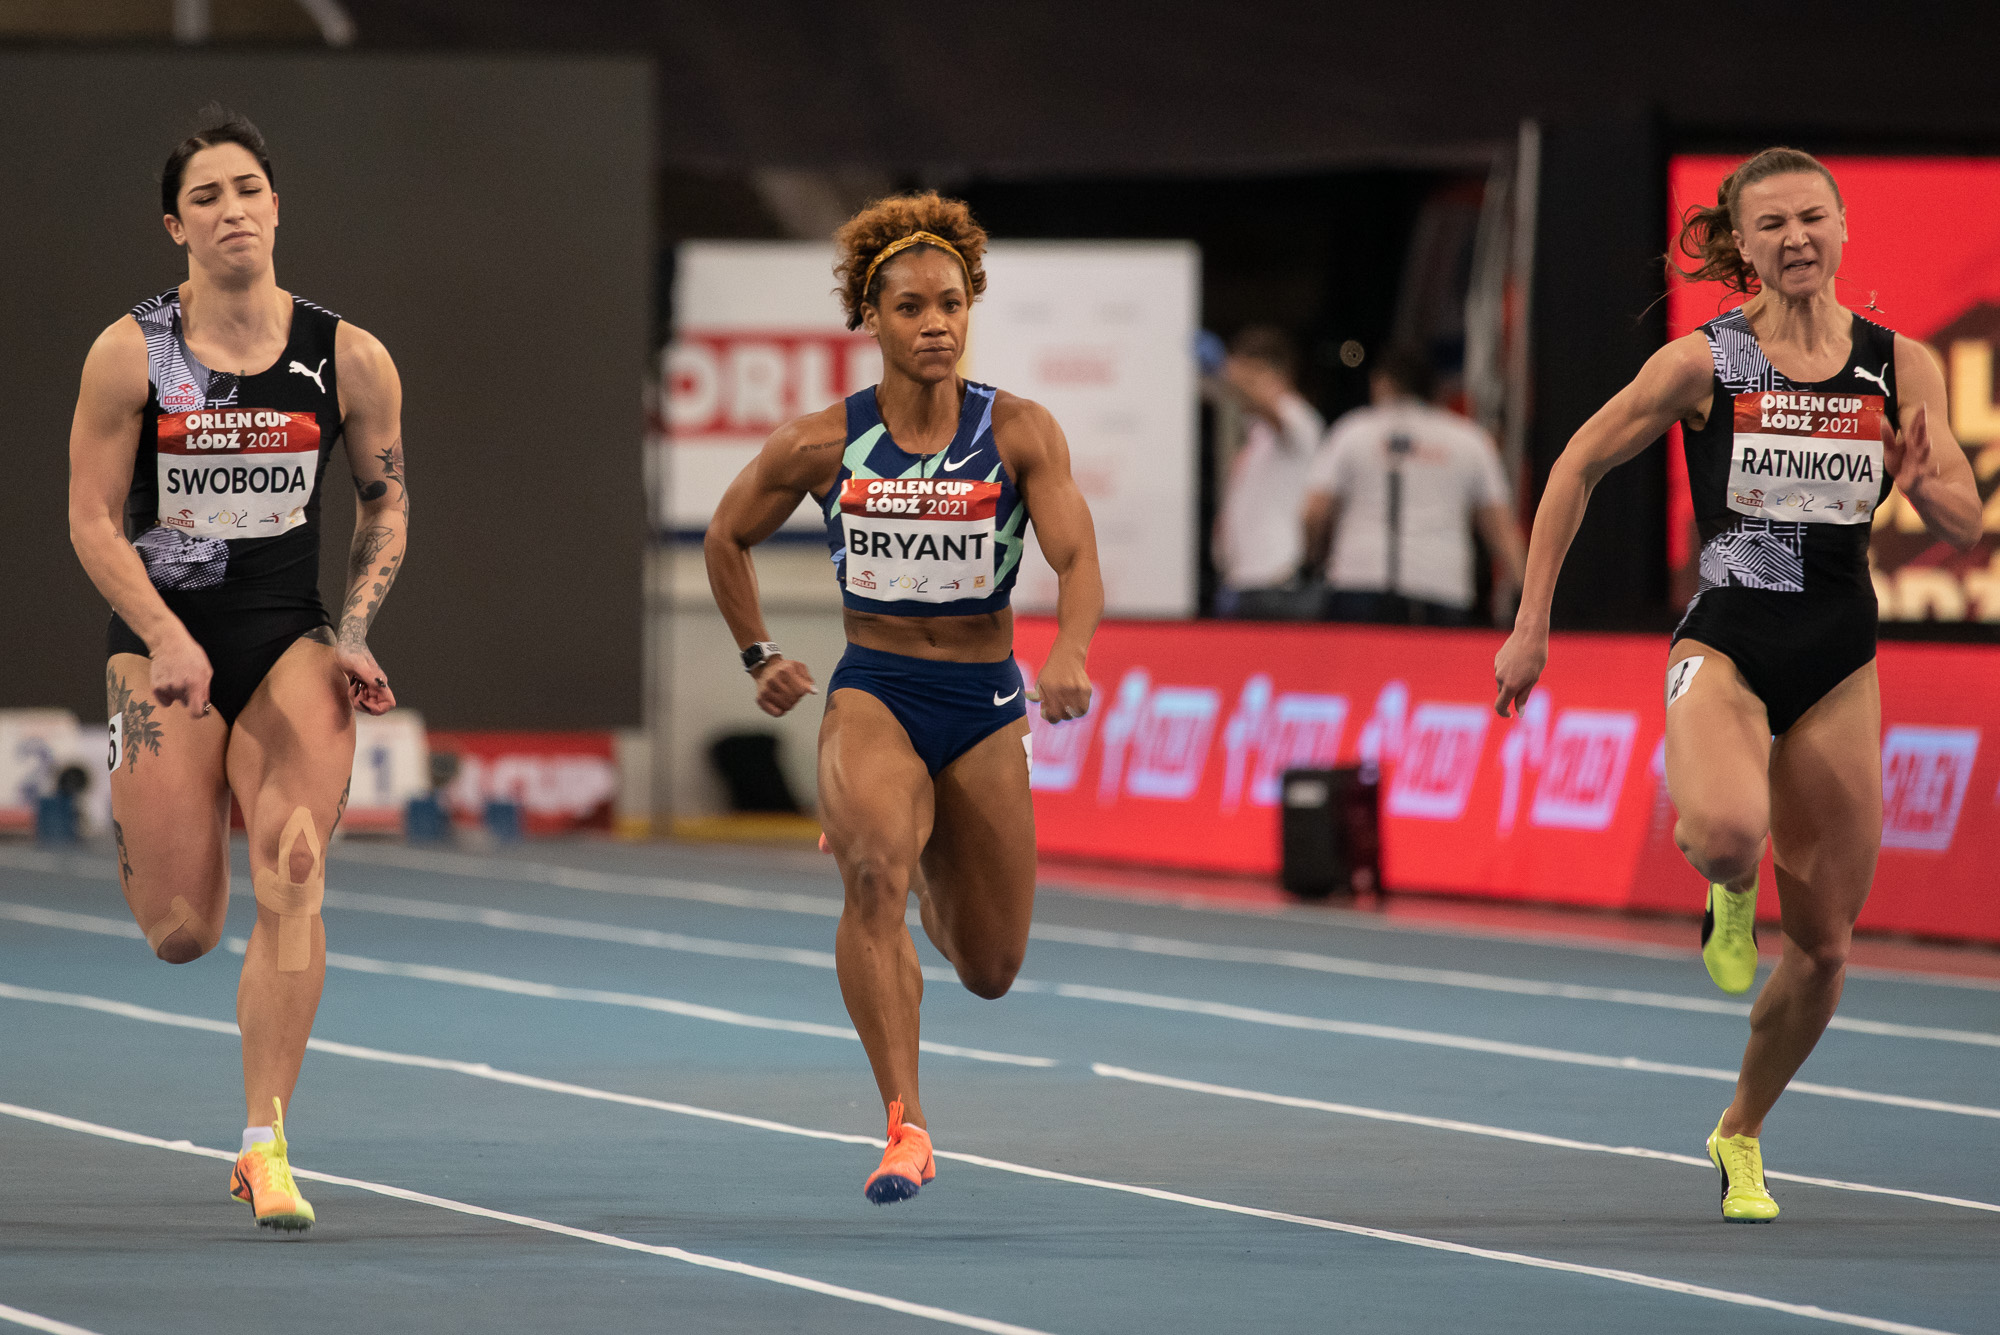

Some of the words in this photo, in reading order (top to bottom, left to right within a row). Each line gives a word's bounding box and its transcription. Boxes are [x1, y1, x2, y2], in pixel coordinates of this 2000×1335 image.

[1760, 394, 1826, 413] ORLEN
[1827, 397, 1863, 414] CUP
[185, 412, 252, 429] ORLEN
[254, 411, 292, 427] CUP
[1761, 410, 1813, 431] ŁÓDŹ
[1818, 417, 1859, 434] 2021
[185, 429, 241, 450] ŁÓDŹ
[247, 431, 288, 449] 2021
[1741, 447, 1874, 483] RATNIKOVA
[166, 465, 306, 496] SWOBODA
[867, 481, 934, 495] ORLEN
[935, 482, 975, 496] CUP
[865, 496, 920, 514] ŁÓDŹ
[926, 499, 968, 516] 2021
[1737, 497, 1763, 507] ORLEN
[168, 518, 193, 527] ORLEN
[849, 528, 989, 561] BRYANT
[852, 578, 876, 589] ORLEN
[107, 723, 117, 771] 6
